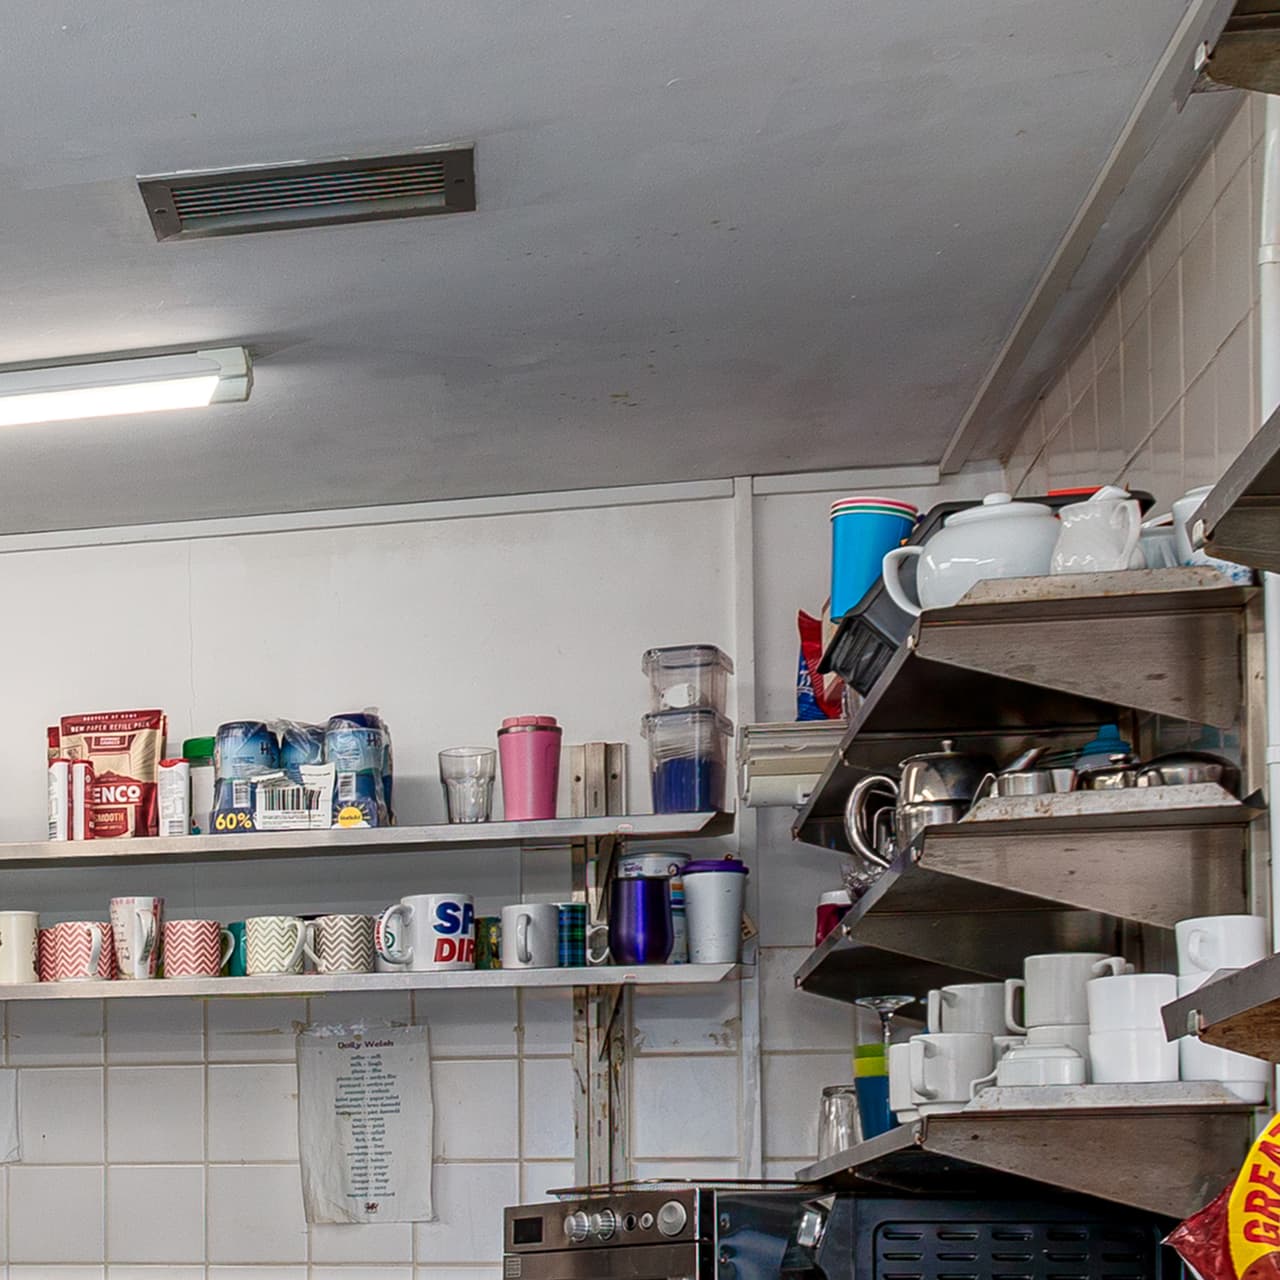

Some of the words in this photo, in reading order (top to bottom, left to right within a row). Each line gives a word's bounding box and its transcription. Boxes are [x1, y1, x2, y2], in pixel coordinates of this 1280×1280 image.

[86, 724, 107, 732] PAPER
[109, 723, 132, 731] REFILL
[93, 785, 141, 802] ENCO
[215, 812, 252, 830] 60%
